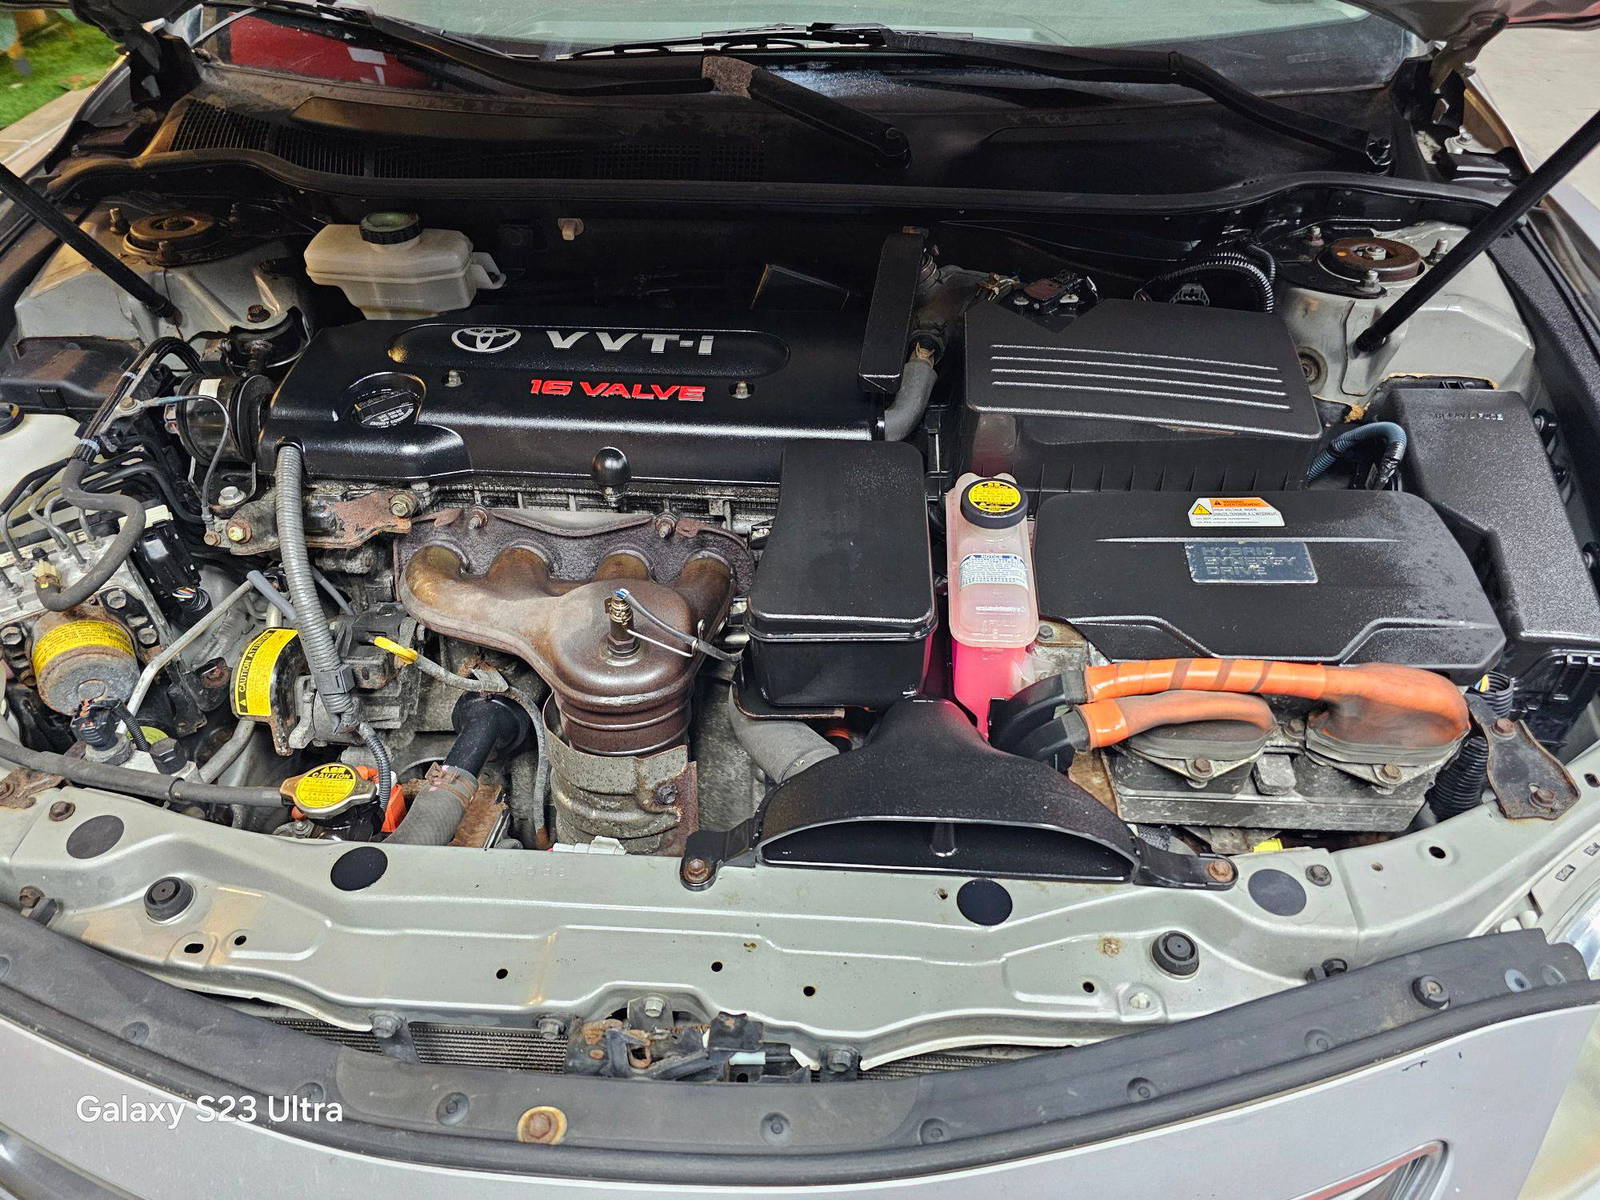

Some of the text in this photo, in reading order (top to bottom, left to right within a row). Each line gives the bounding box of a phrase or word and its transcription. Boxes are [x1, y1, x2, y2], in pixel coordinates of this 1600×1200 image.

[546, 330, 715, 356] VVT-i
[530, 379, 707, 402] 16 VALVE
[1202, 547, 1276, 556] HYBRID
[1206, 566, 1268, 576] DRIVE
[238, 659, 252, 693] CAUTION
[247, 630, 275, 658] ATTEON
[311, 771, 352, 779] CAUTION
